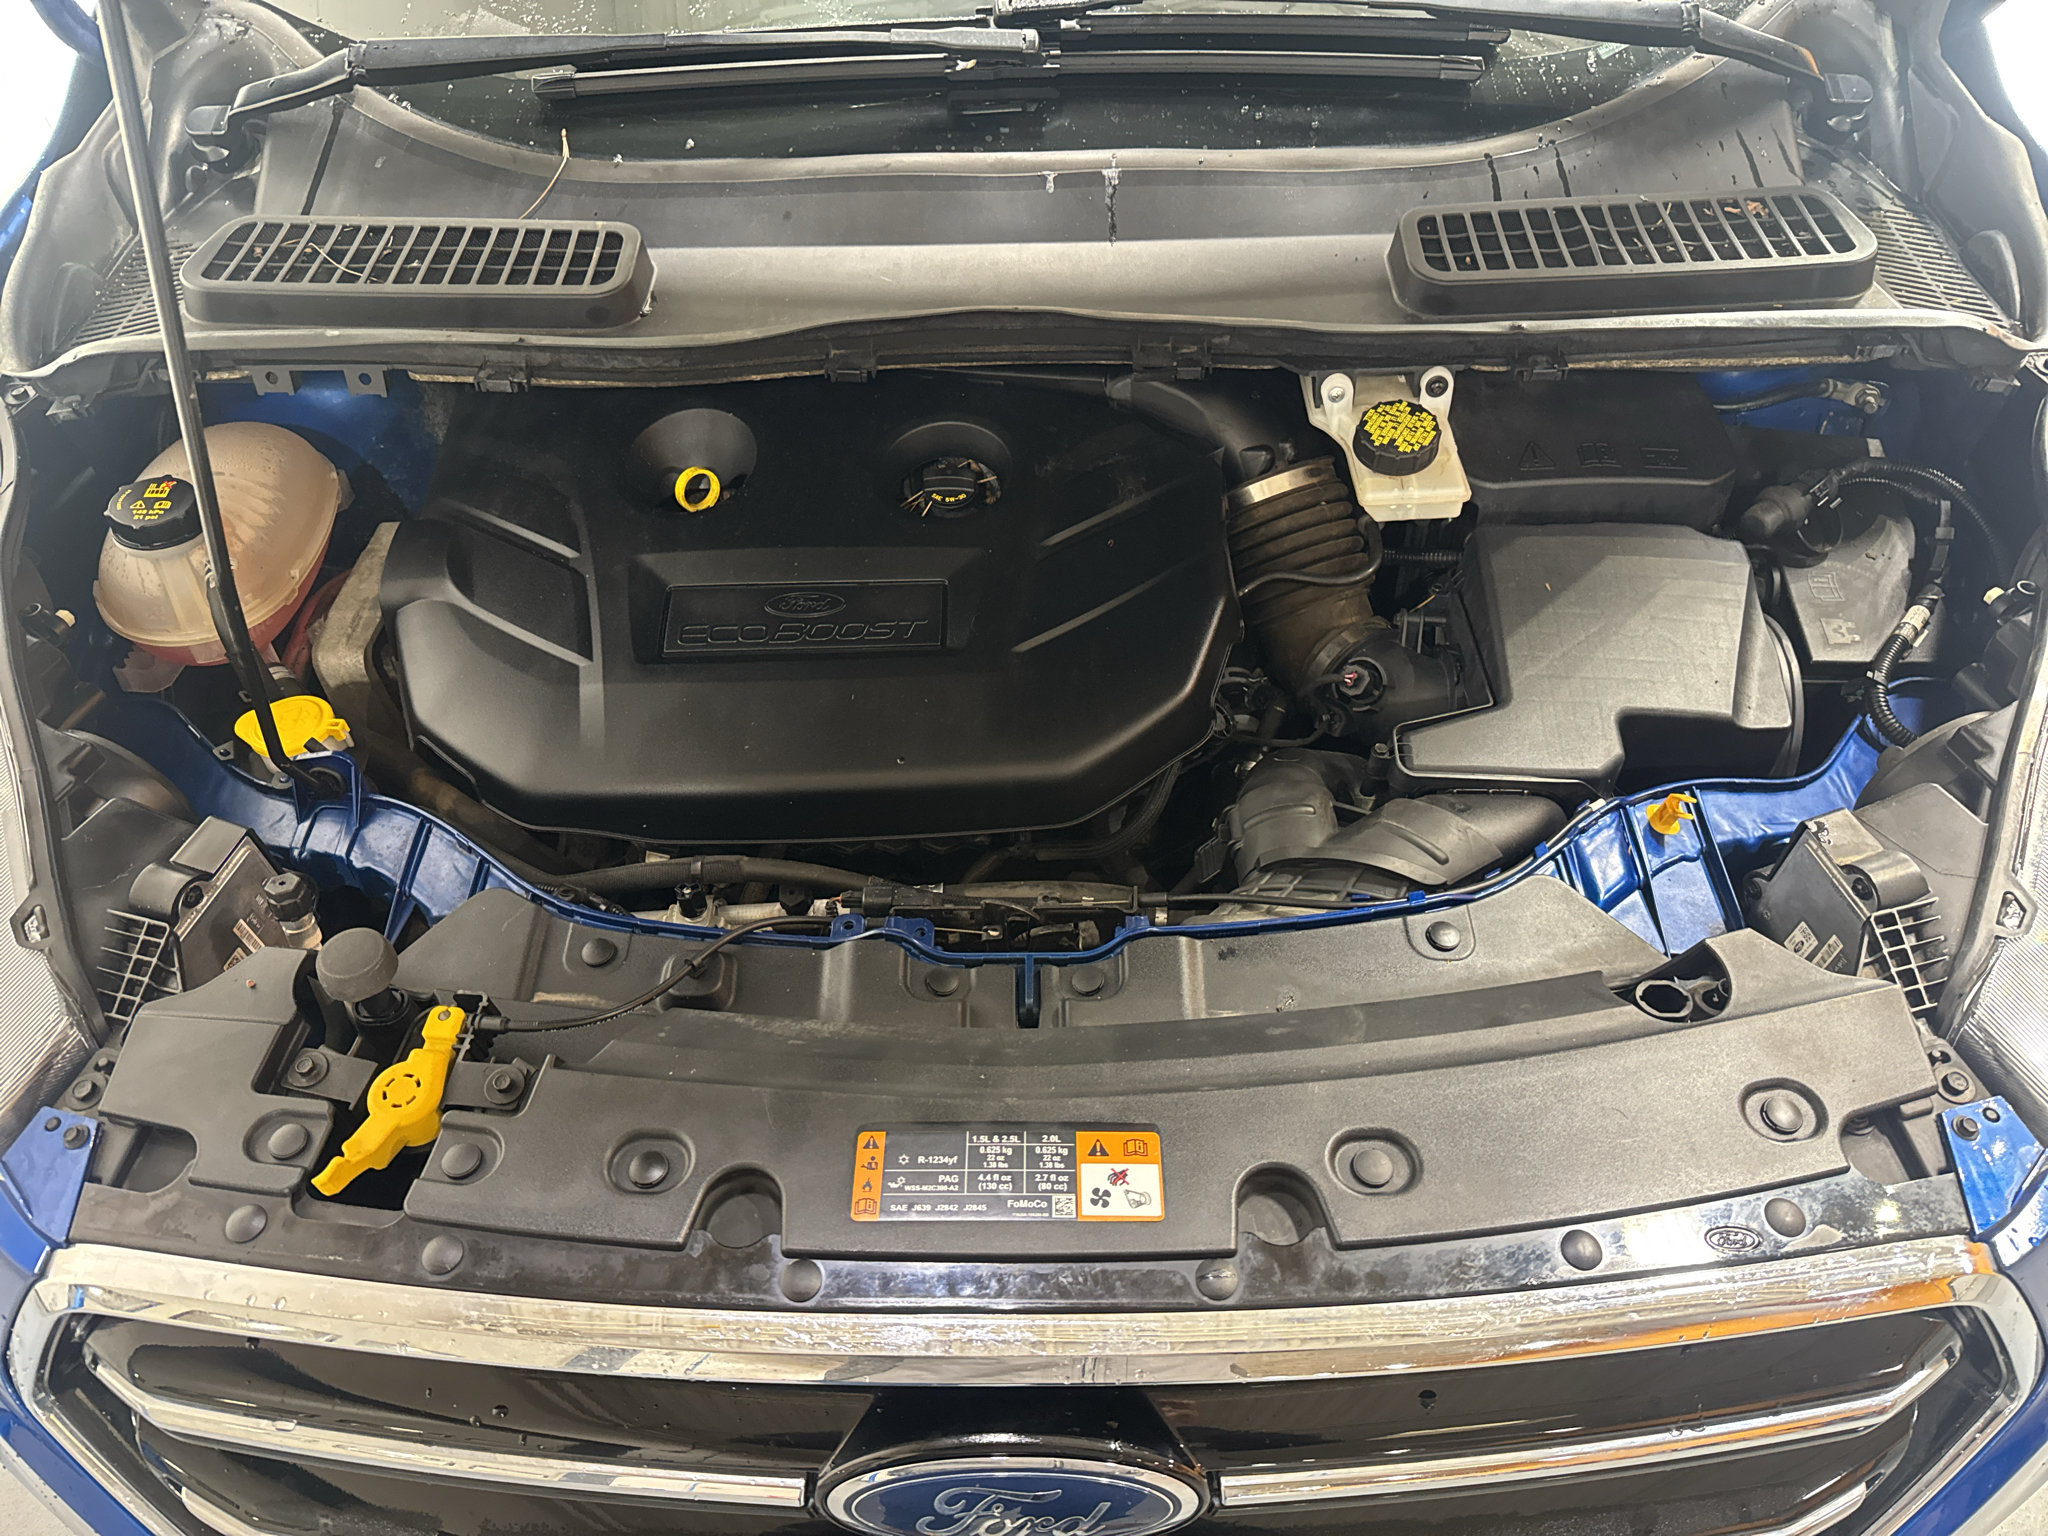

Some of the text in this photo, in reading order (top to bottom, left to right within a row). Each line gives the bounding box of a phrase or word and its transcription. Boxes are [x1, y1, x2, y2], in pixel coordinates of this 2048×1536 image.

[972, 1135, 1021, 1143] 1.5L & 2.5L
[1041, 1135, 1062, 1143] 2.0L
[979, 1146, 1013, 1155] 0.625 kg
[1035, 1146, 1069, 1155] 0.625 kg
[917, 1156, 958, 1165] R-1234yf
[938, 1175, 959, 1183] PAG
[977, 1173, 992, 1181] 4.4
[992, 1173, 1000, 1181] fl
[1034, 1173, 1048, 1181] 2.7
[1049, 1173, 1057, 1181] fl
[978, 1182, 1013, 1191] (130 cc)
[1038, 1182, 1068, 1191] (80 cc)
[1007, 1200, 1048, 1208] FoMoCo
[915, 1486, 1112, 1536] Ford
